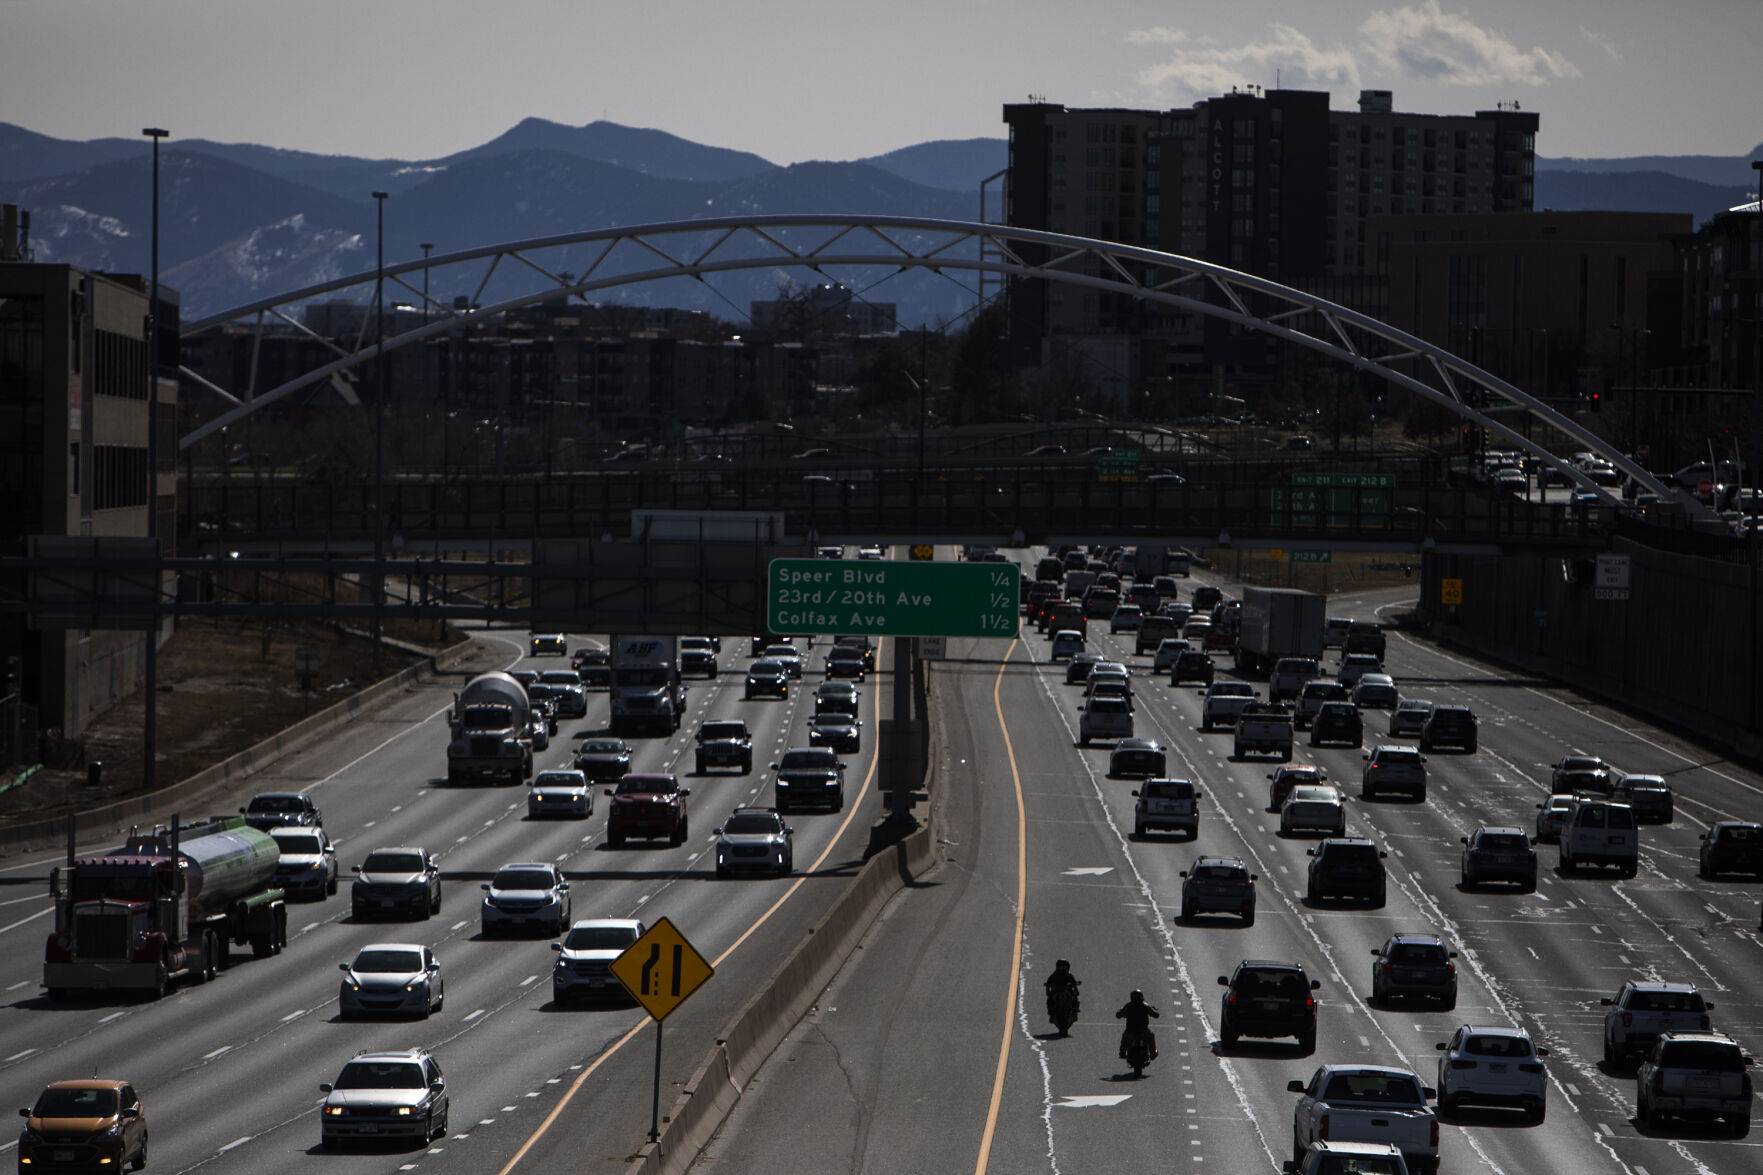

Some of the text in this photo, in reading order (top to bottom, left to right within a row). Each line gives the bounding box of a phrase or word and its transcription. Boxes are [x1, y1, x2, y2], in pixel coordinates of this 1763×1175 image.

[1212, 119, 1223, 212] ALCOTT
[778, 568, 832, 584] Speer
[843, 569, 886, 584] Blvd
[896, 591, 933, 607] Ave
[777, 610, 838, 626] Colfax
[849, 612, 886, 627] Ave
